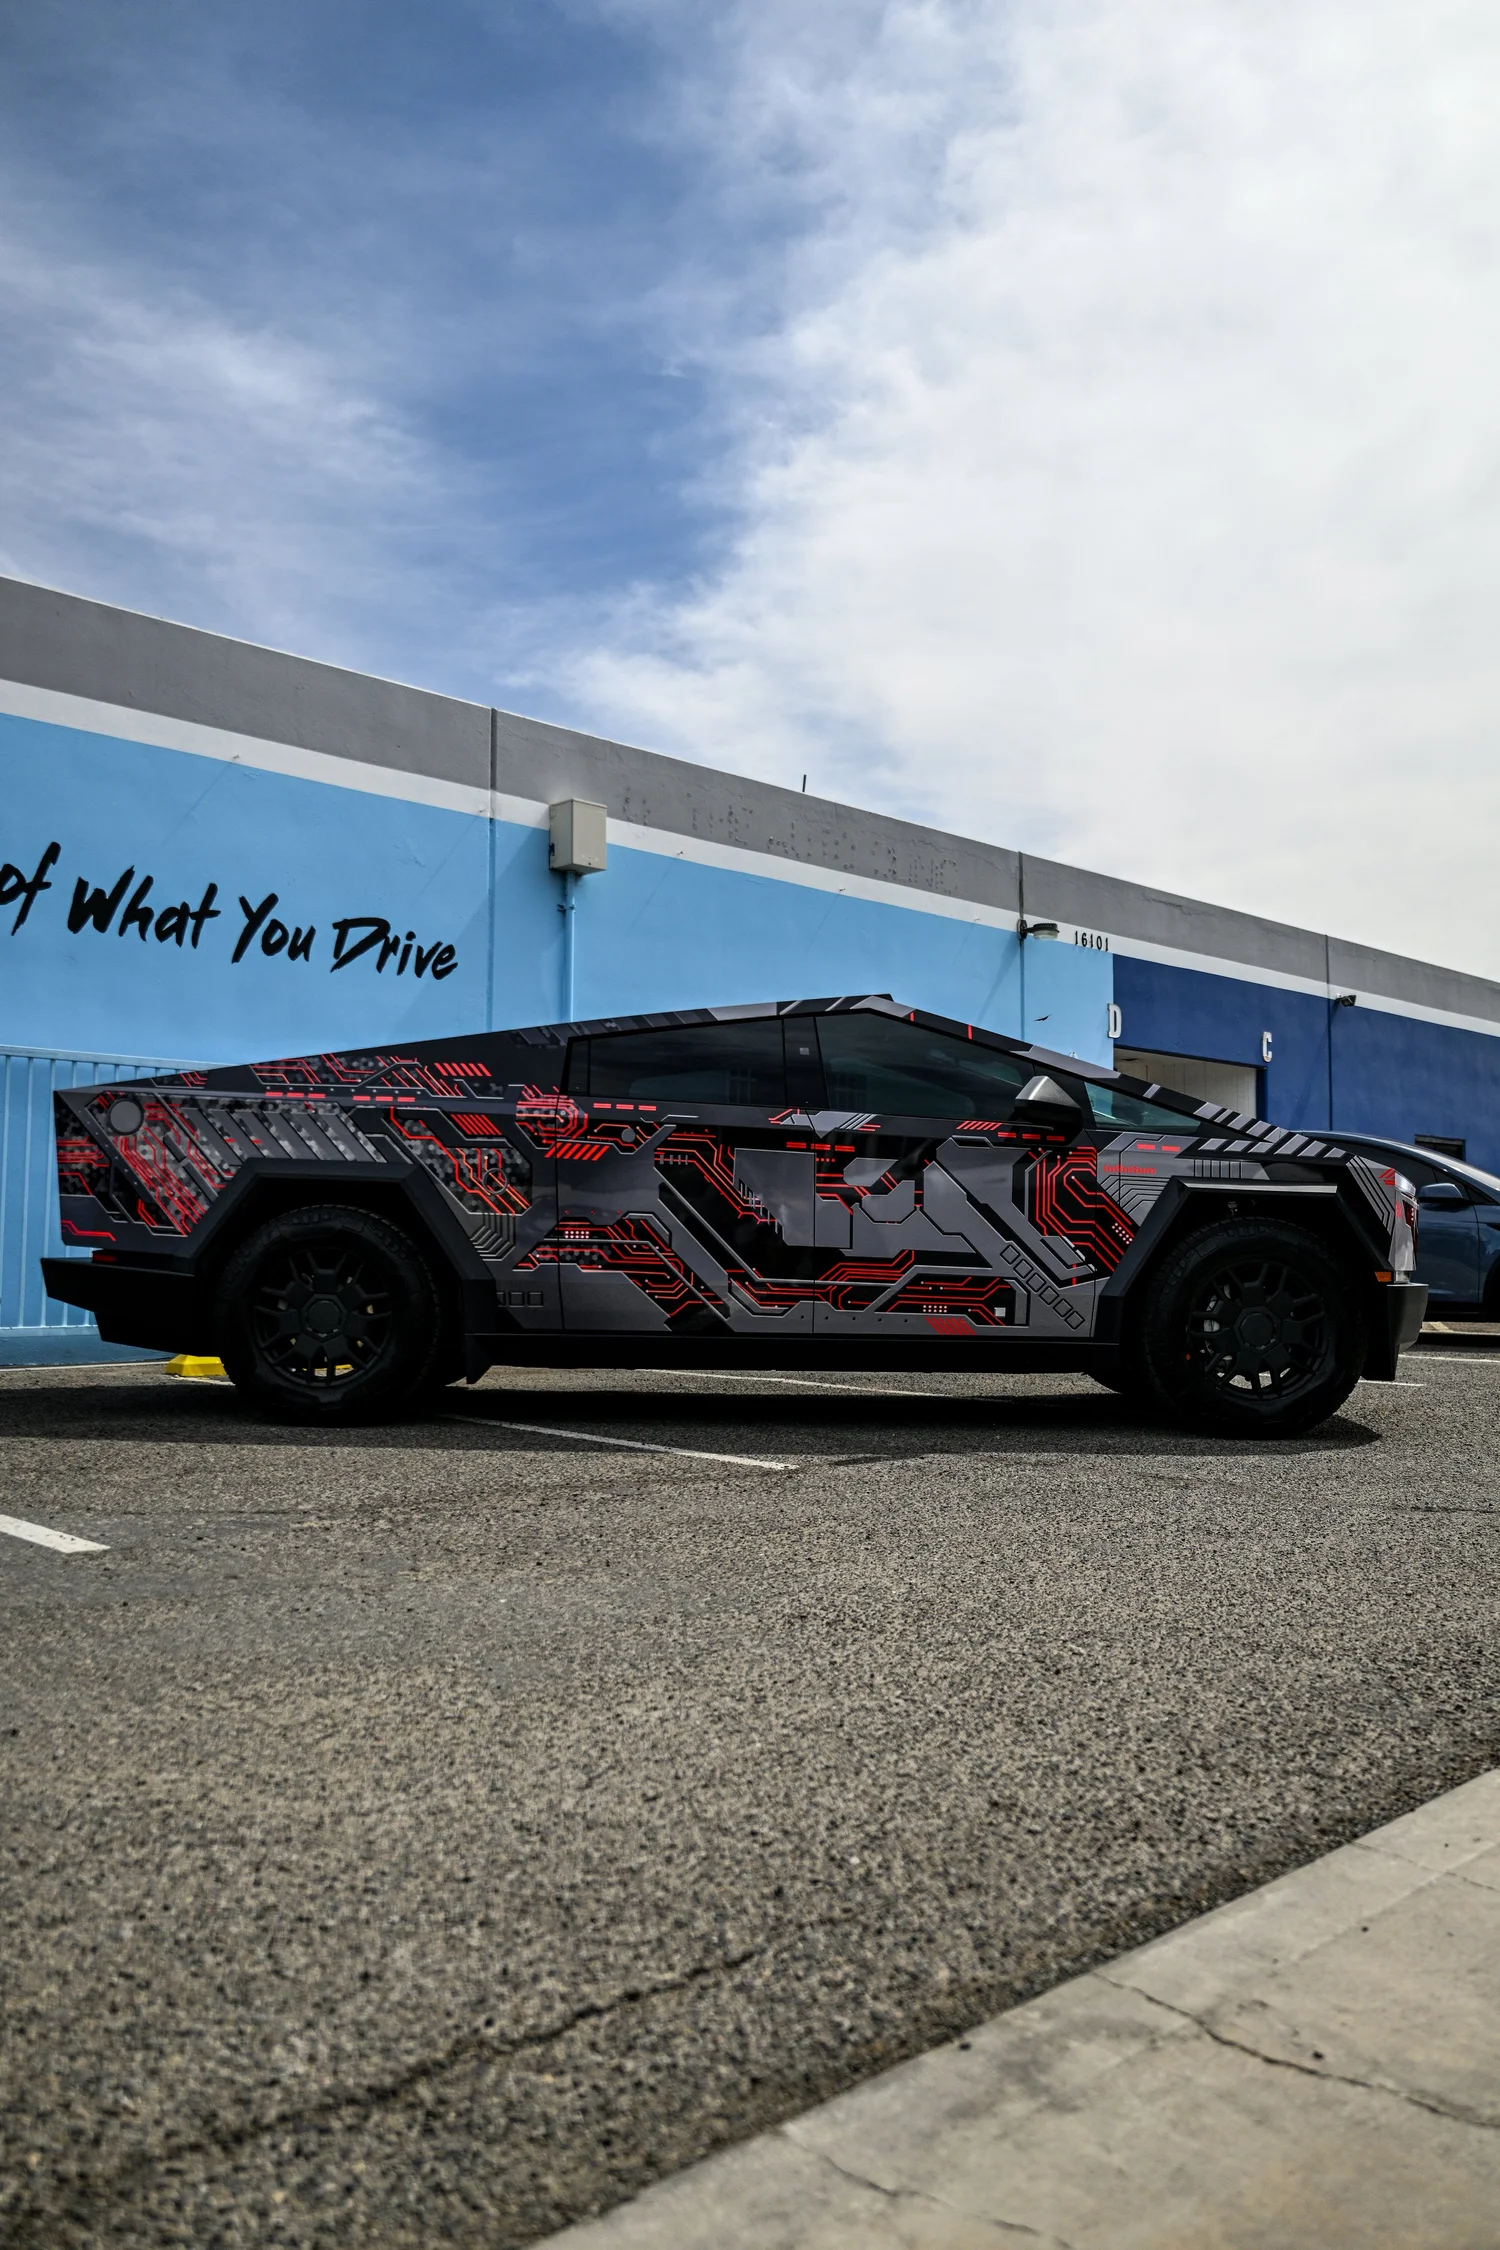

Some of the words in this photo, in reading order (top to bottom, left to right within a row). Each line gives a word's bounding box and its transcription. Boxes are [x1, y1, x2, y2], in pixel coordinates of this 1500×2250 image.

[0, 842, 61, 936] of
[67, 866, 221, 949] What
[231, 892, 316, 964] You
[330, 917, 458, 980] Drive
[1074, 930, 1109, 952] 16101
[1107, 1003, 1122, 1039] D
[1262, 1031, 1273, 1063] C
